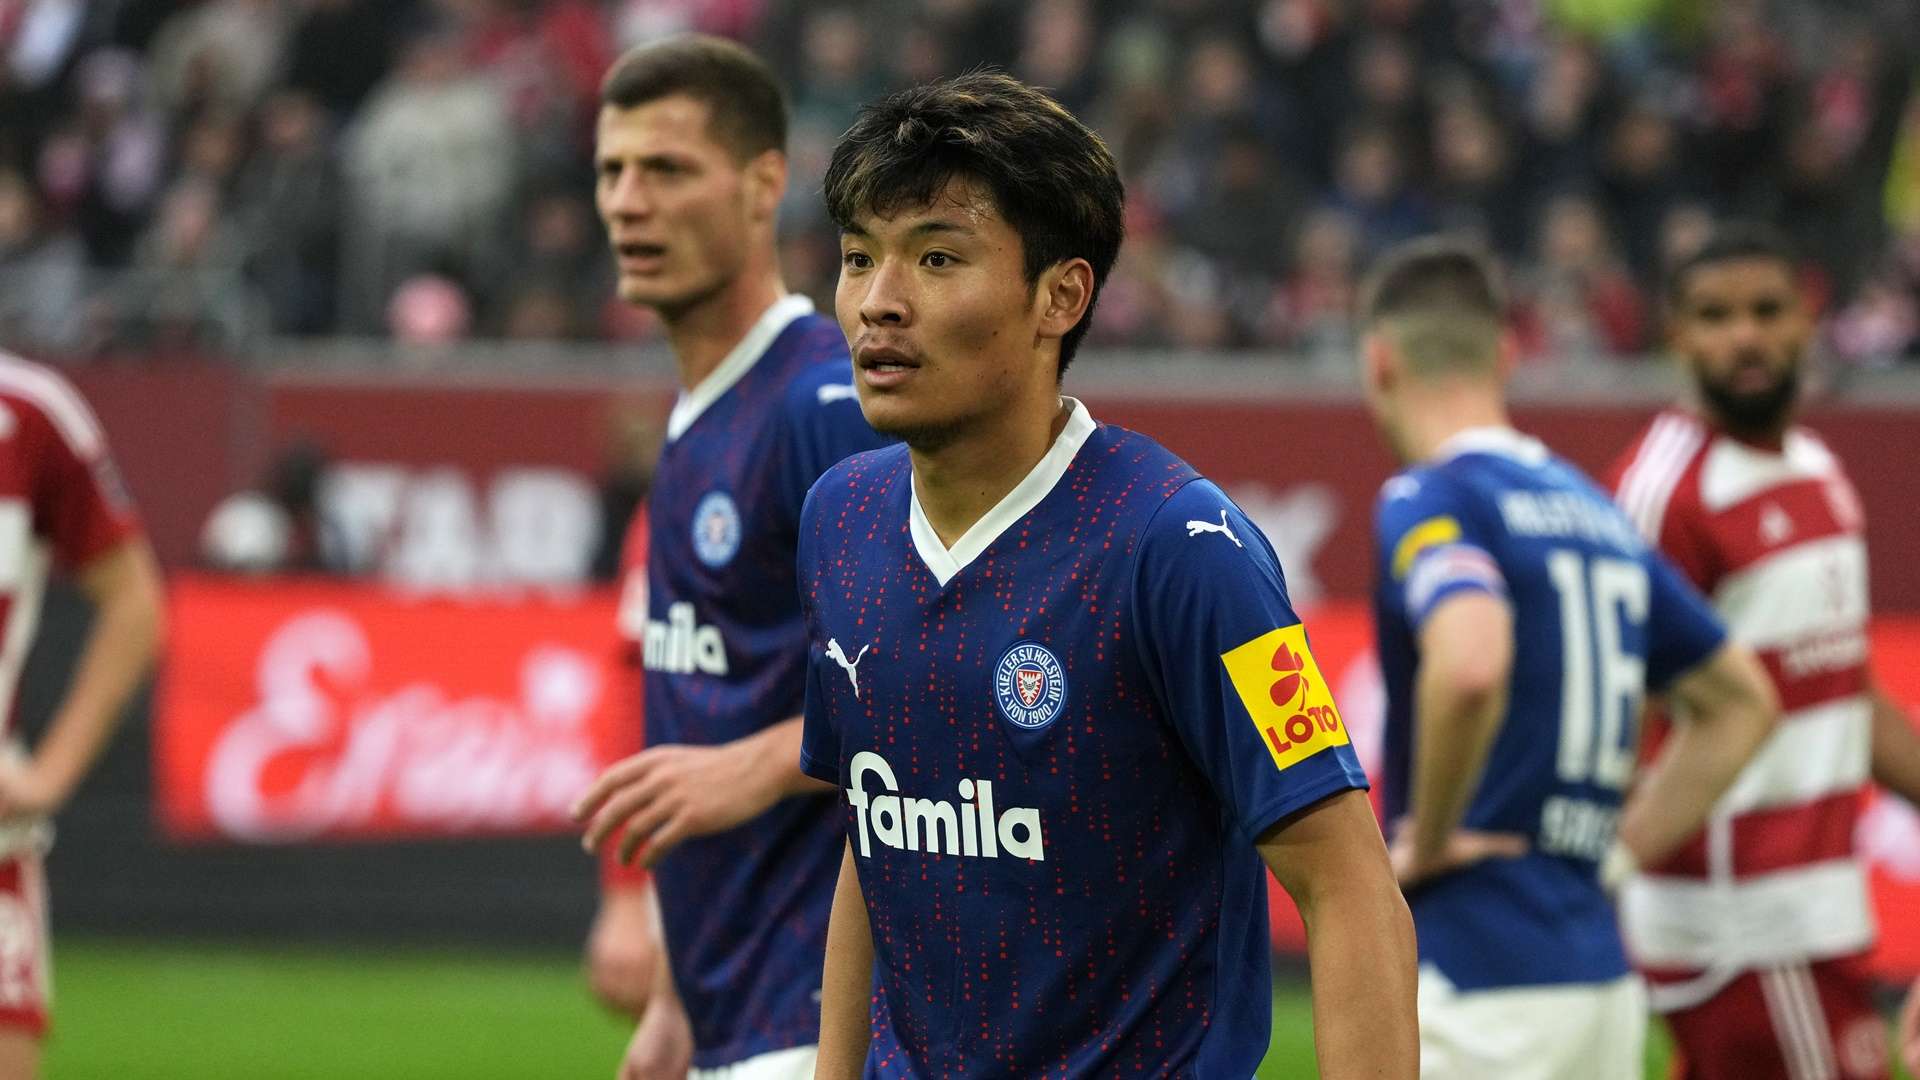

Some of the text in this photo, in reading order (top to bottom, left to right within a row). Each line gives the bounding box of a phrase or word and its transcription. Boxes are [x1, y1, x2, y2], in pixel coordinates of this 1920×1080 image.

[999, 653, 1021, 696] KIELER
[1033, 649, 1062, 702] HOLSTEIN
[1548, 549, 1650, 790] 16
[1005, 699, 1052, 724] VON 1900
[1266, 704, 1338, 754] LOTO
[846, 751, 1045, 861] famila
